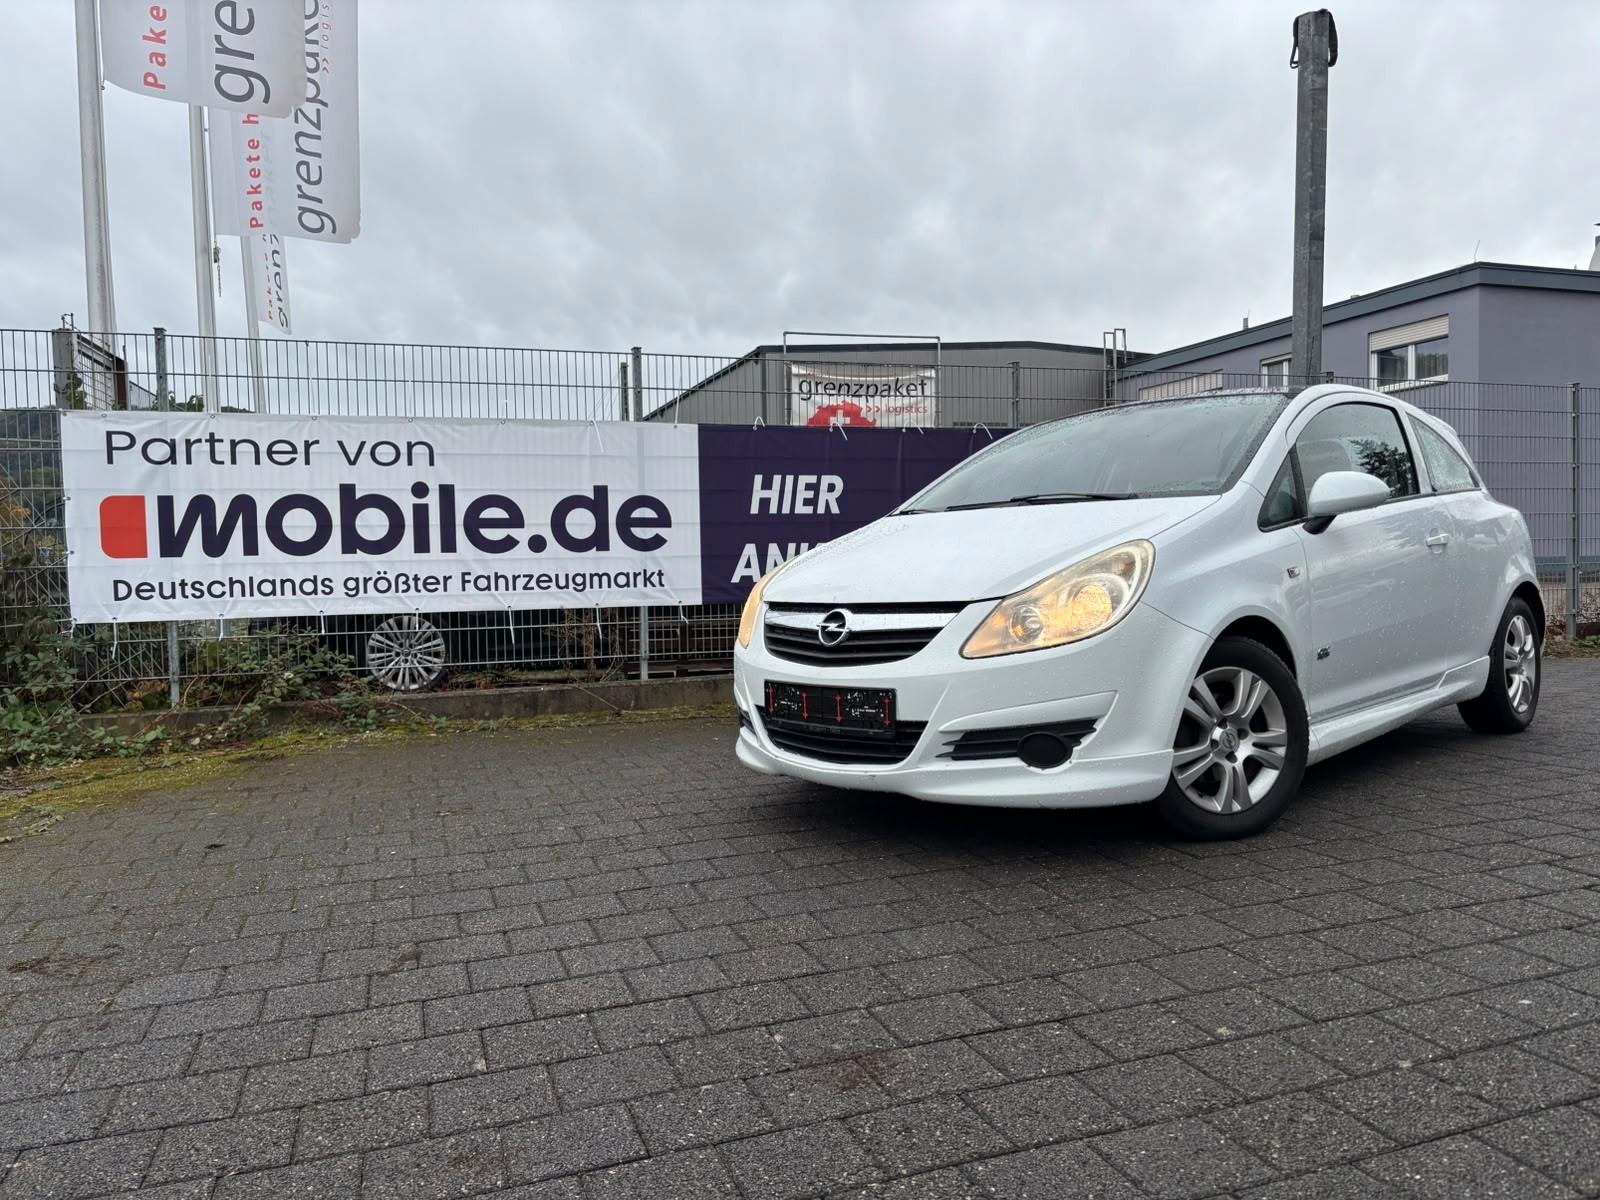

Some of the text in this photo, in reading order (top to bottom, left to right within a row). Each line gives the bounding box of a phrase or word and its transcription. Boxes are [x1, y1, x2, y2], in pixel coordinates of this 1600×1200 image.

[246, 138, 263, 229] Pakete
[799, 377, 928, 403] grenzpaket
[885, 404, 928, 416] logistics
[106, 430, 435, 467] Partner von
[750, 474, 844, 514] HIER
[157, 481, 672, 559] mobile.de
[113, 568, 665, 602] Deutschlands größter Fahrzeugmarkt
